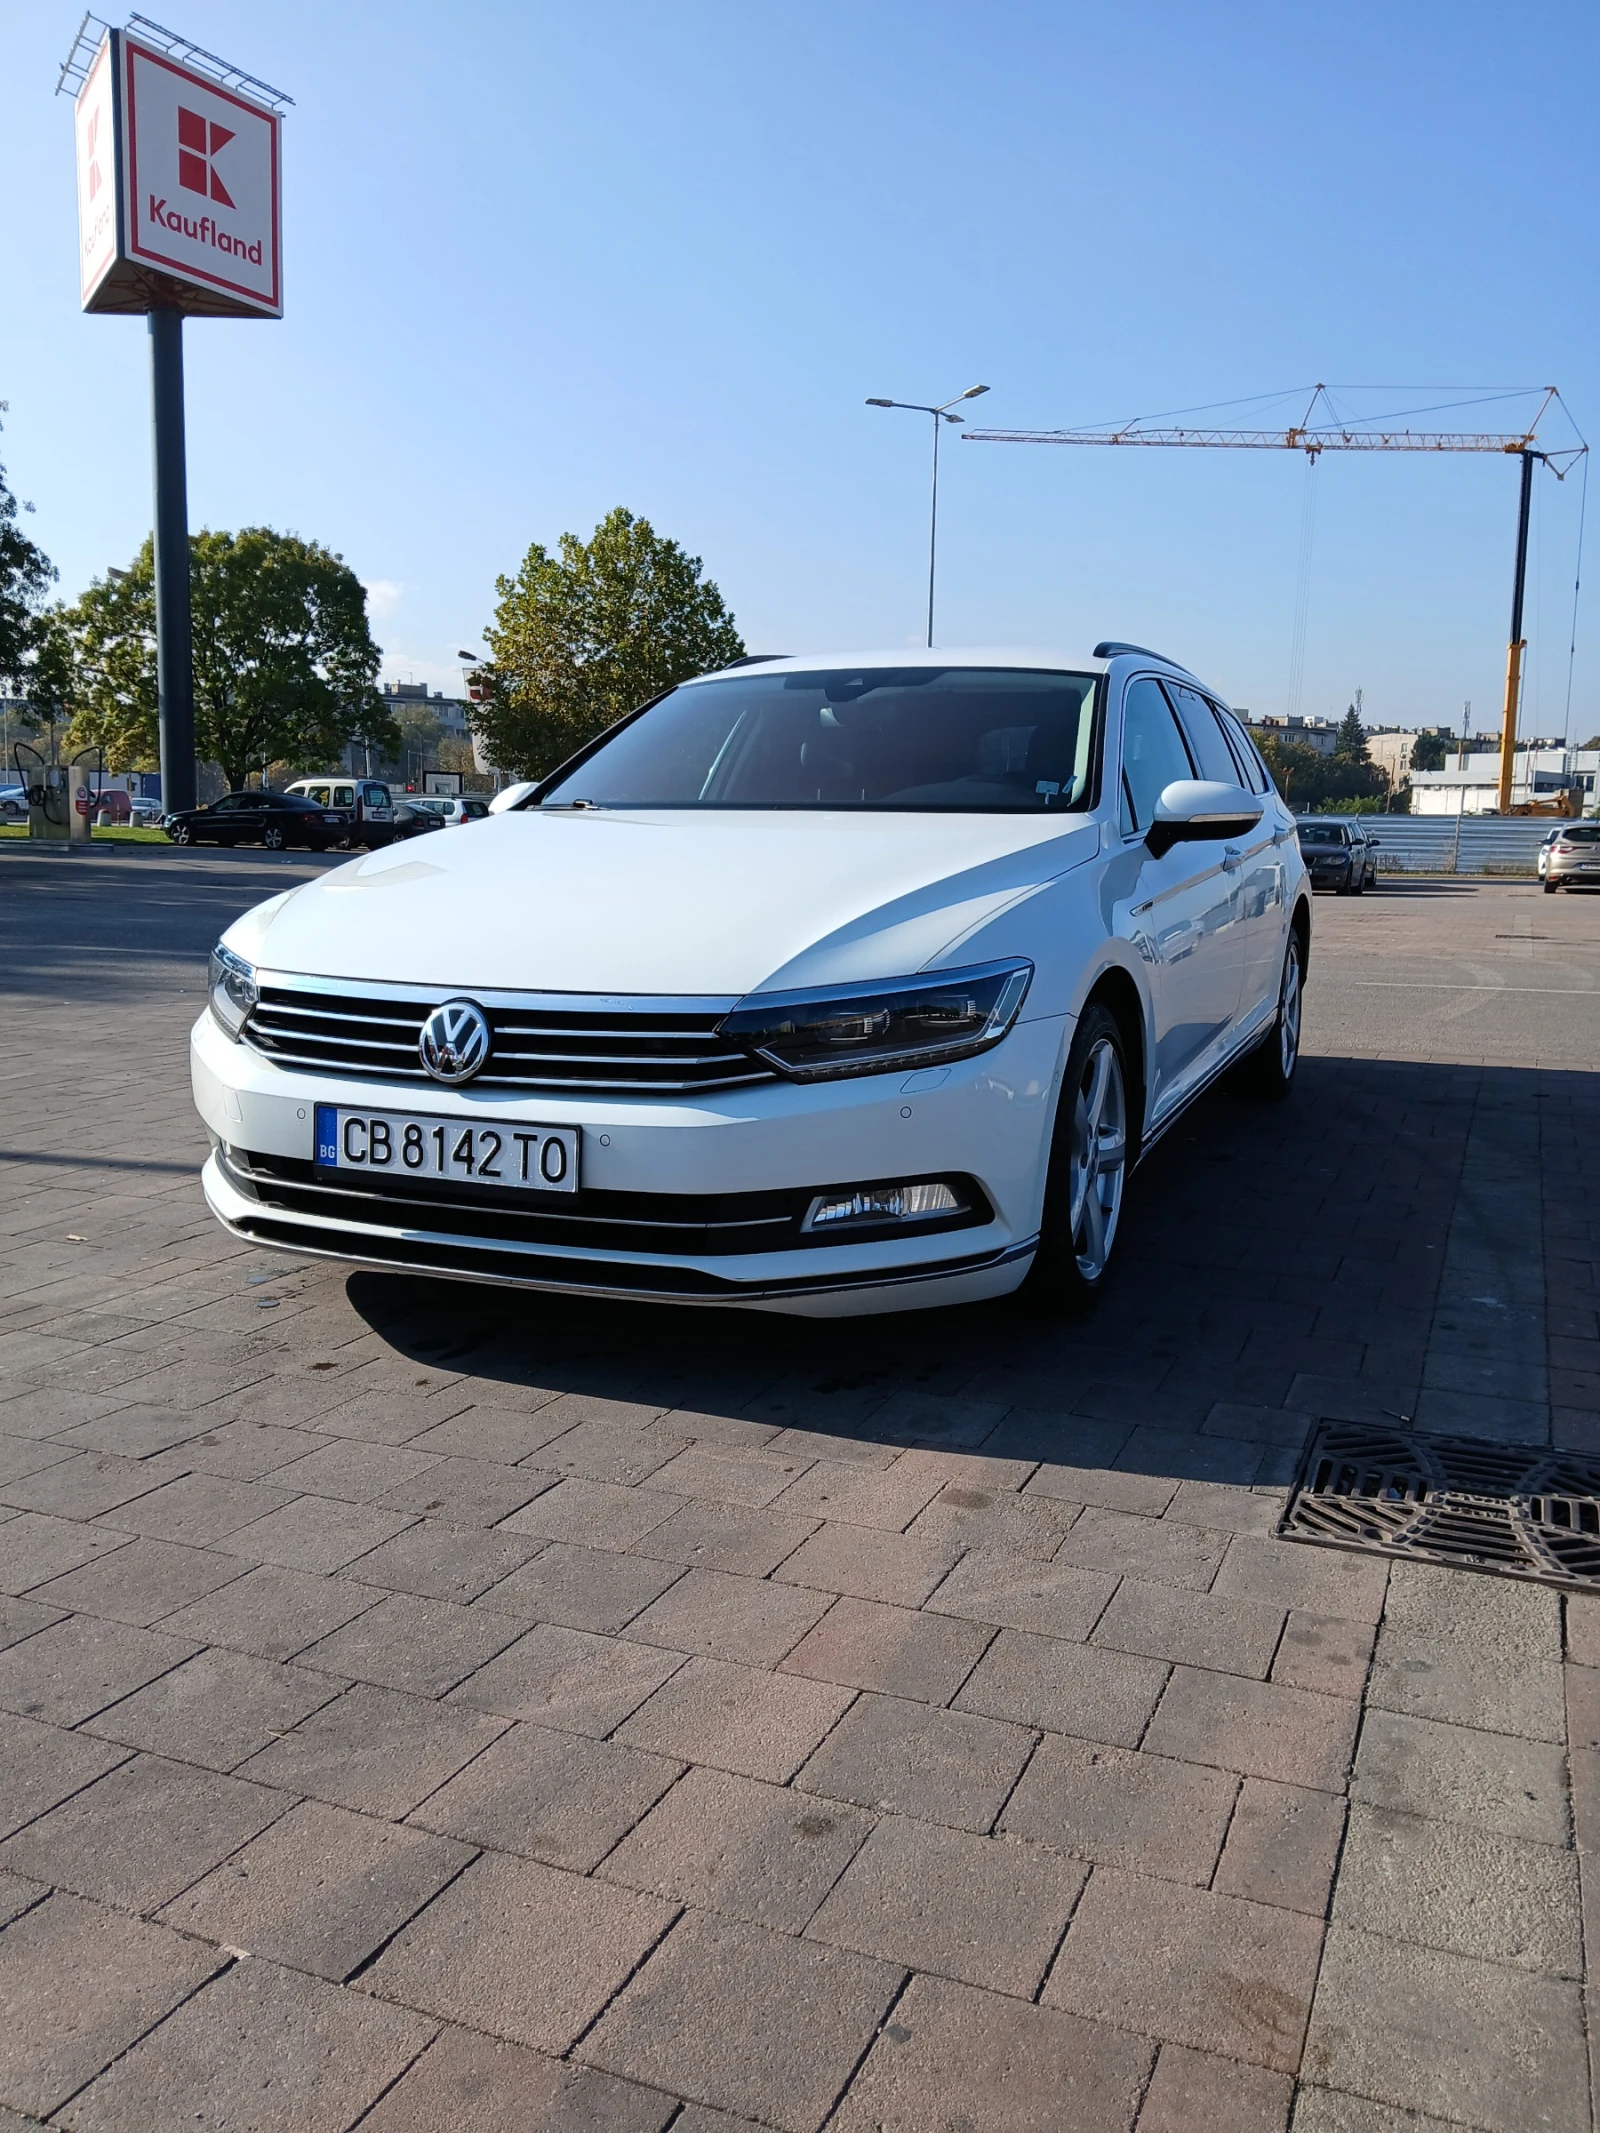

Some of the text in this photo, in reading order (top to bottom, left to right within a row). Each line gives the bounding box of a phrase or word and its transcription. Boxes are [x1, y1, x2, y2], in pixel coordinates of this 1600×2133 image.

[149, 194, 262, 266] Kaufland
[319, 1144, 336, 1159] BG
[343, 1116, 392, 1165] CB
[401, 1123, 502, 1178] 8142
